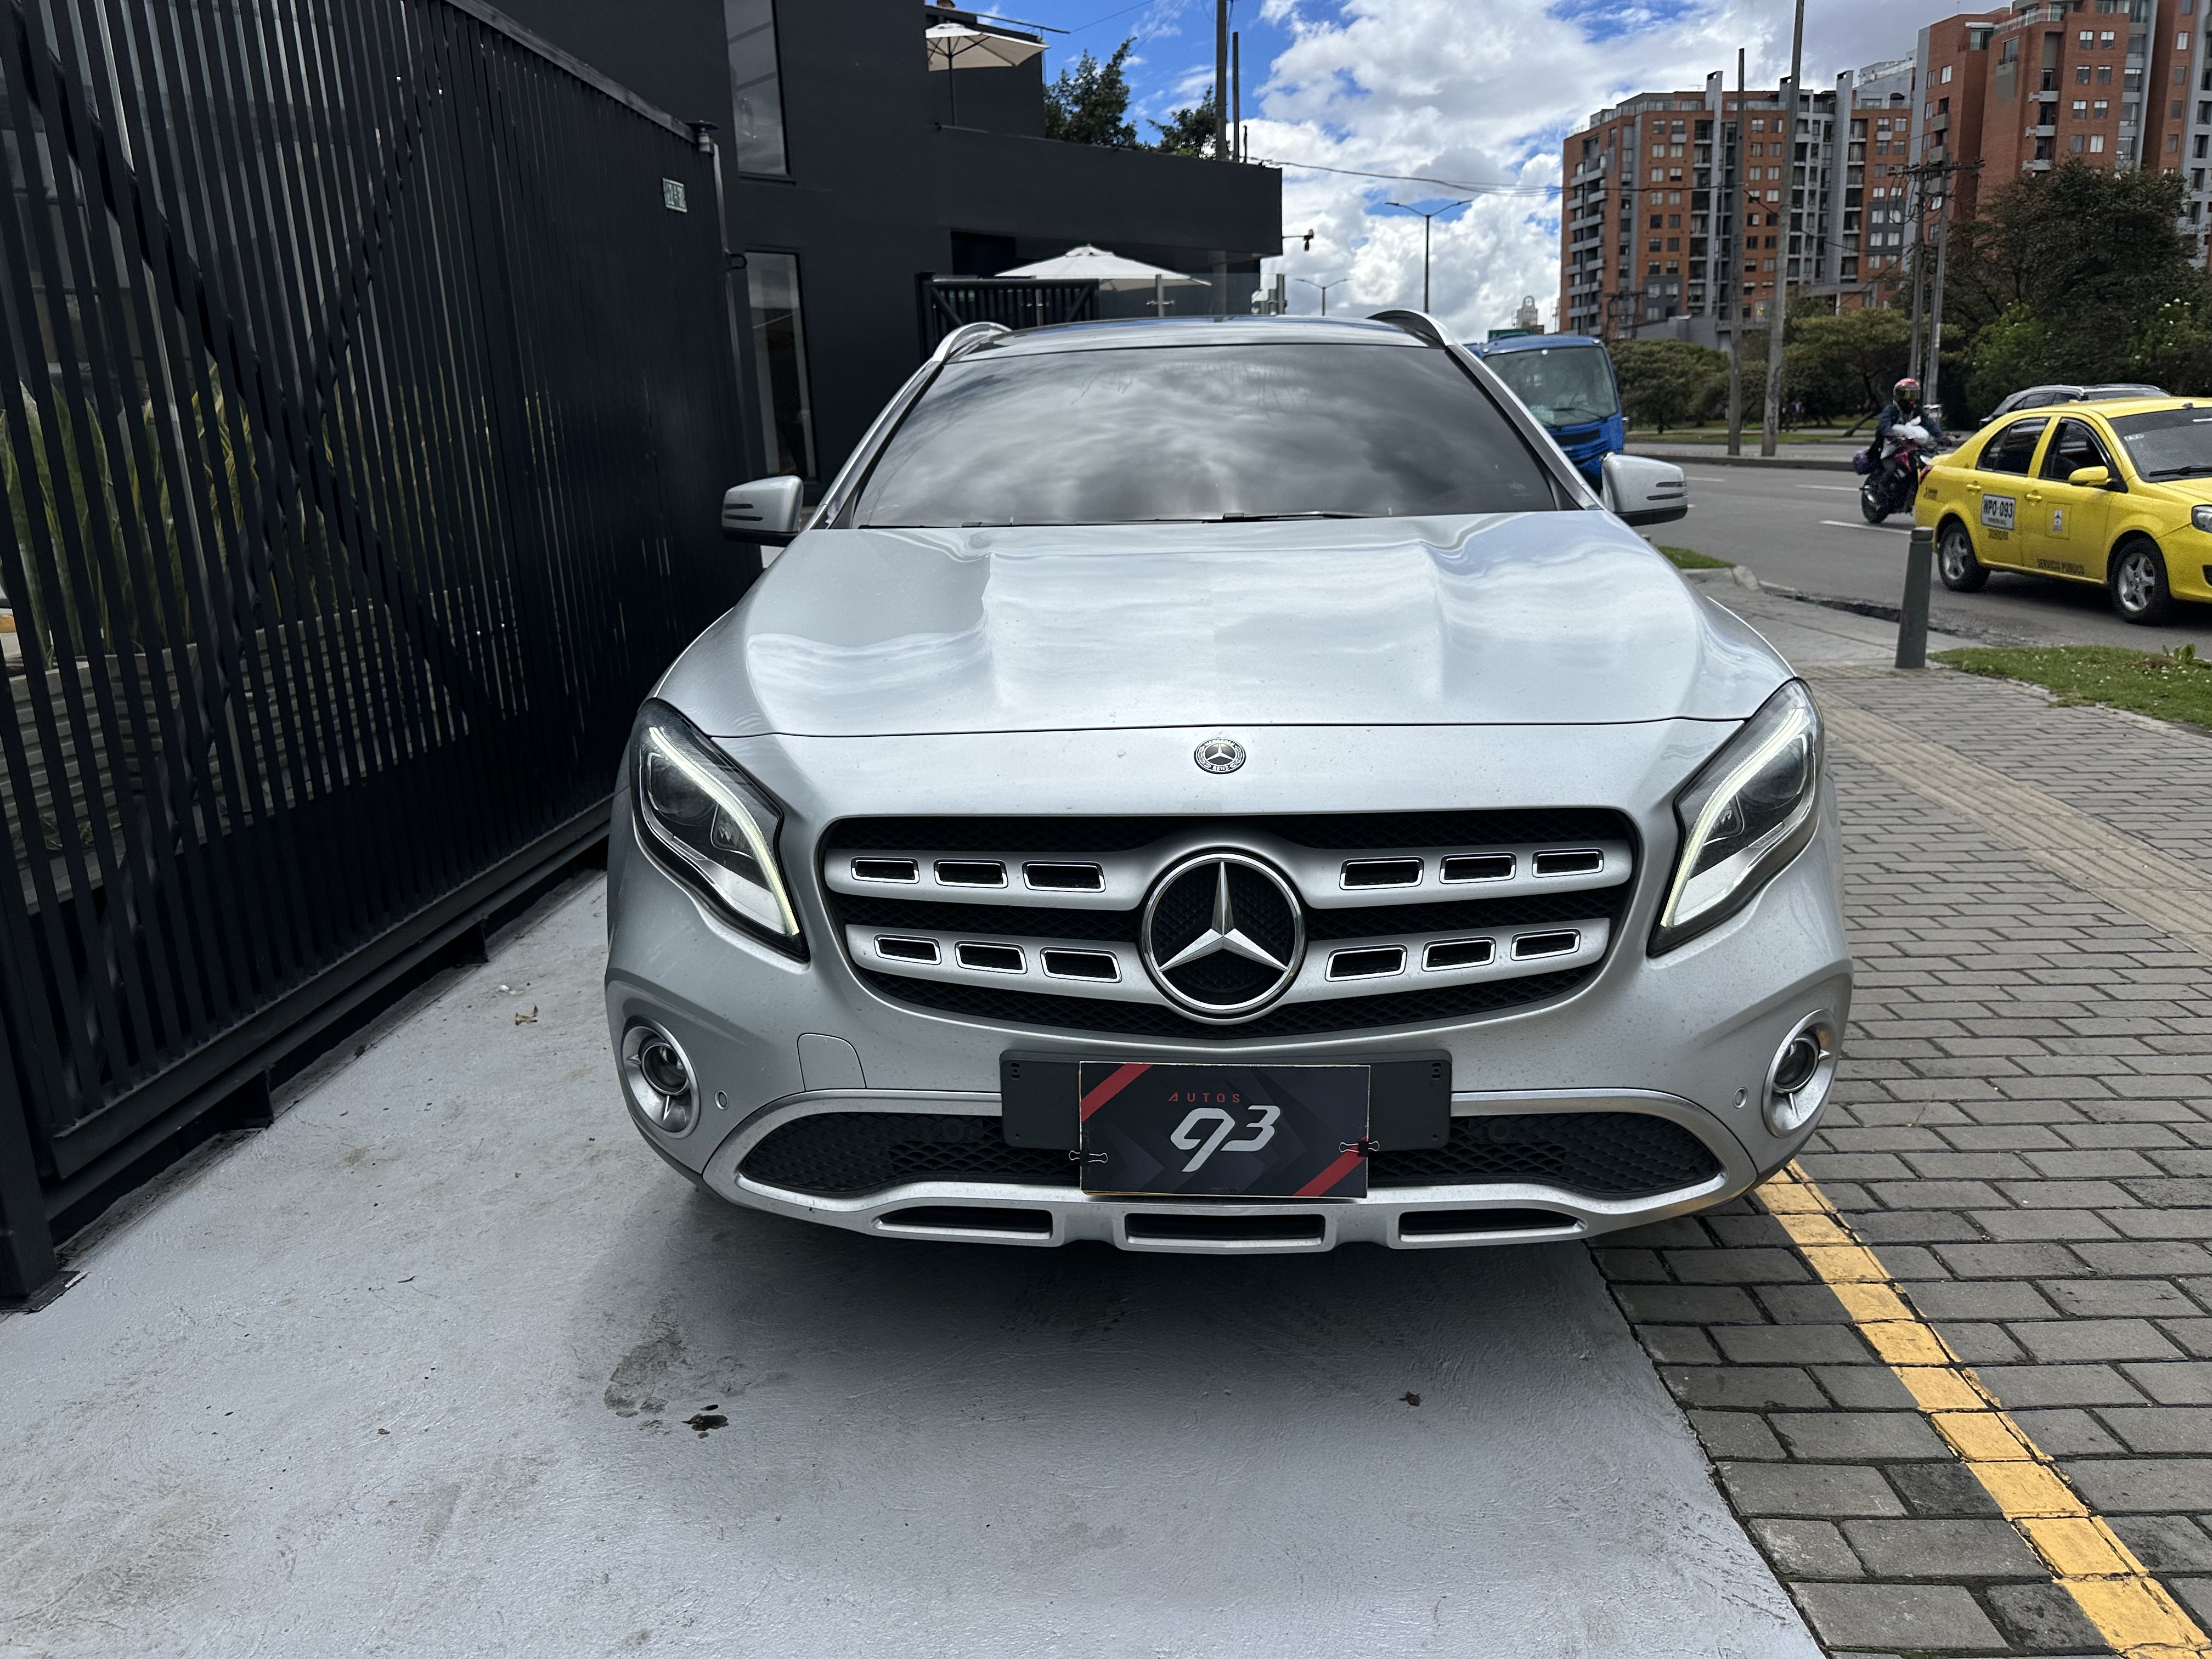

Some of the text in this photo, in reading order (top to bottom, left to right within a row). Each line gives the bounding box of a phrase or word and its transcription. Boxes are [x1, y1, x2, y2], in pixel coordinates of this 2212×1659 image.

[2000, 500, 2013, 518] 093
[1168, 1092, 1240, 1103] AUTOS
[1170, 1105, 1281, 1172] 93
